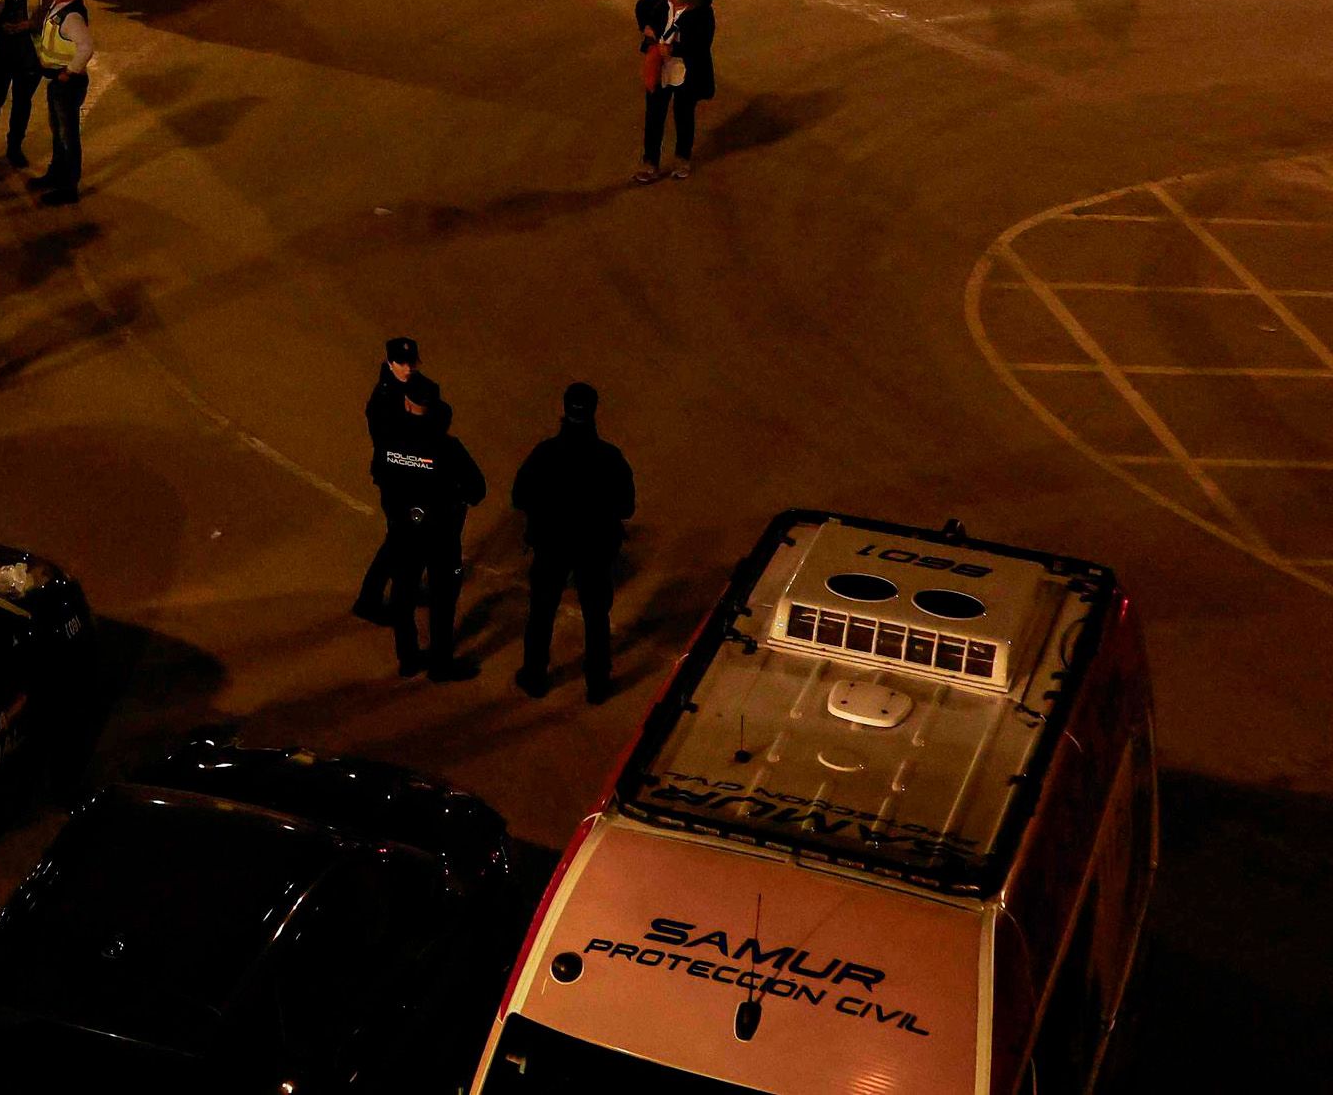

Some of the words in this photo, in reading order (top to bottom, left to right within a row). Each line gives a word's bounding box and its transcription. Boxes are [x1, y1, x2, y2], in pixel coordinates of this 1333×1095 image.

[386, 457, 434, 470] NACIONAL
[643, 918, 885, 993] SAMUR
[835, 996, 930, 1036] CIVIL
